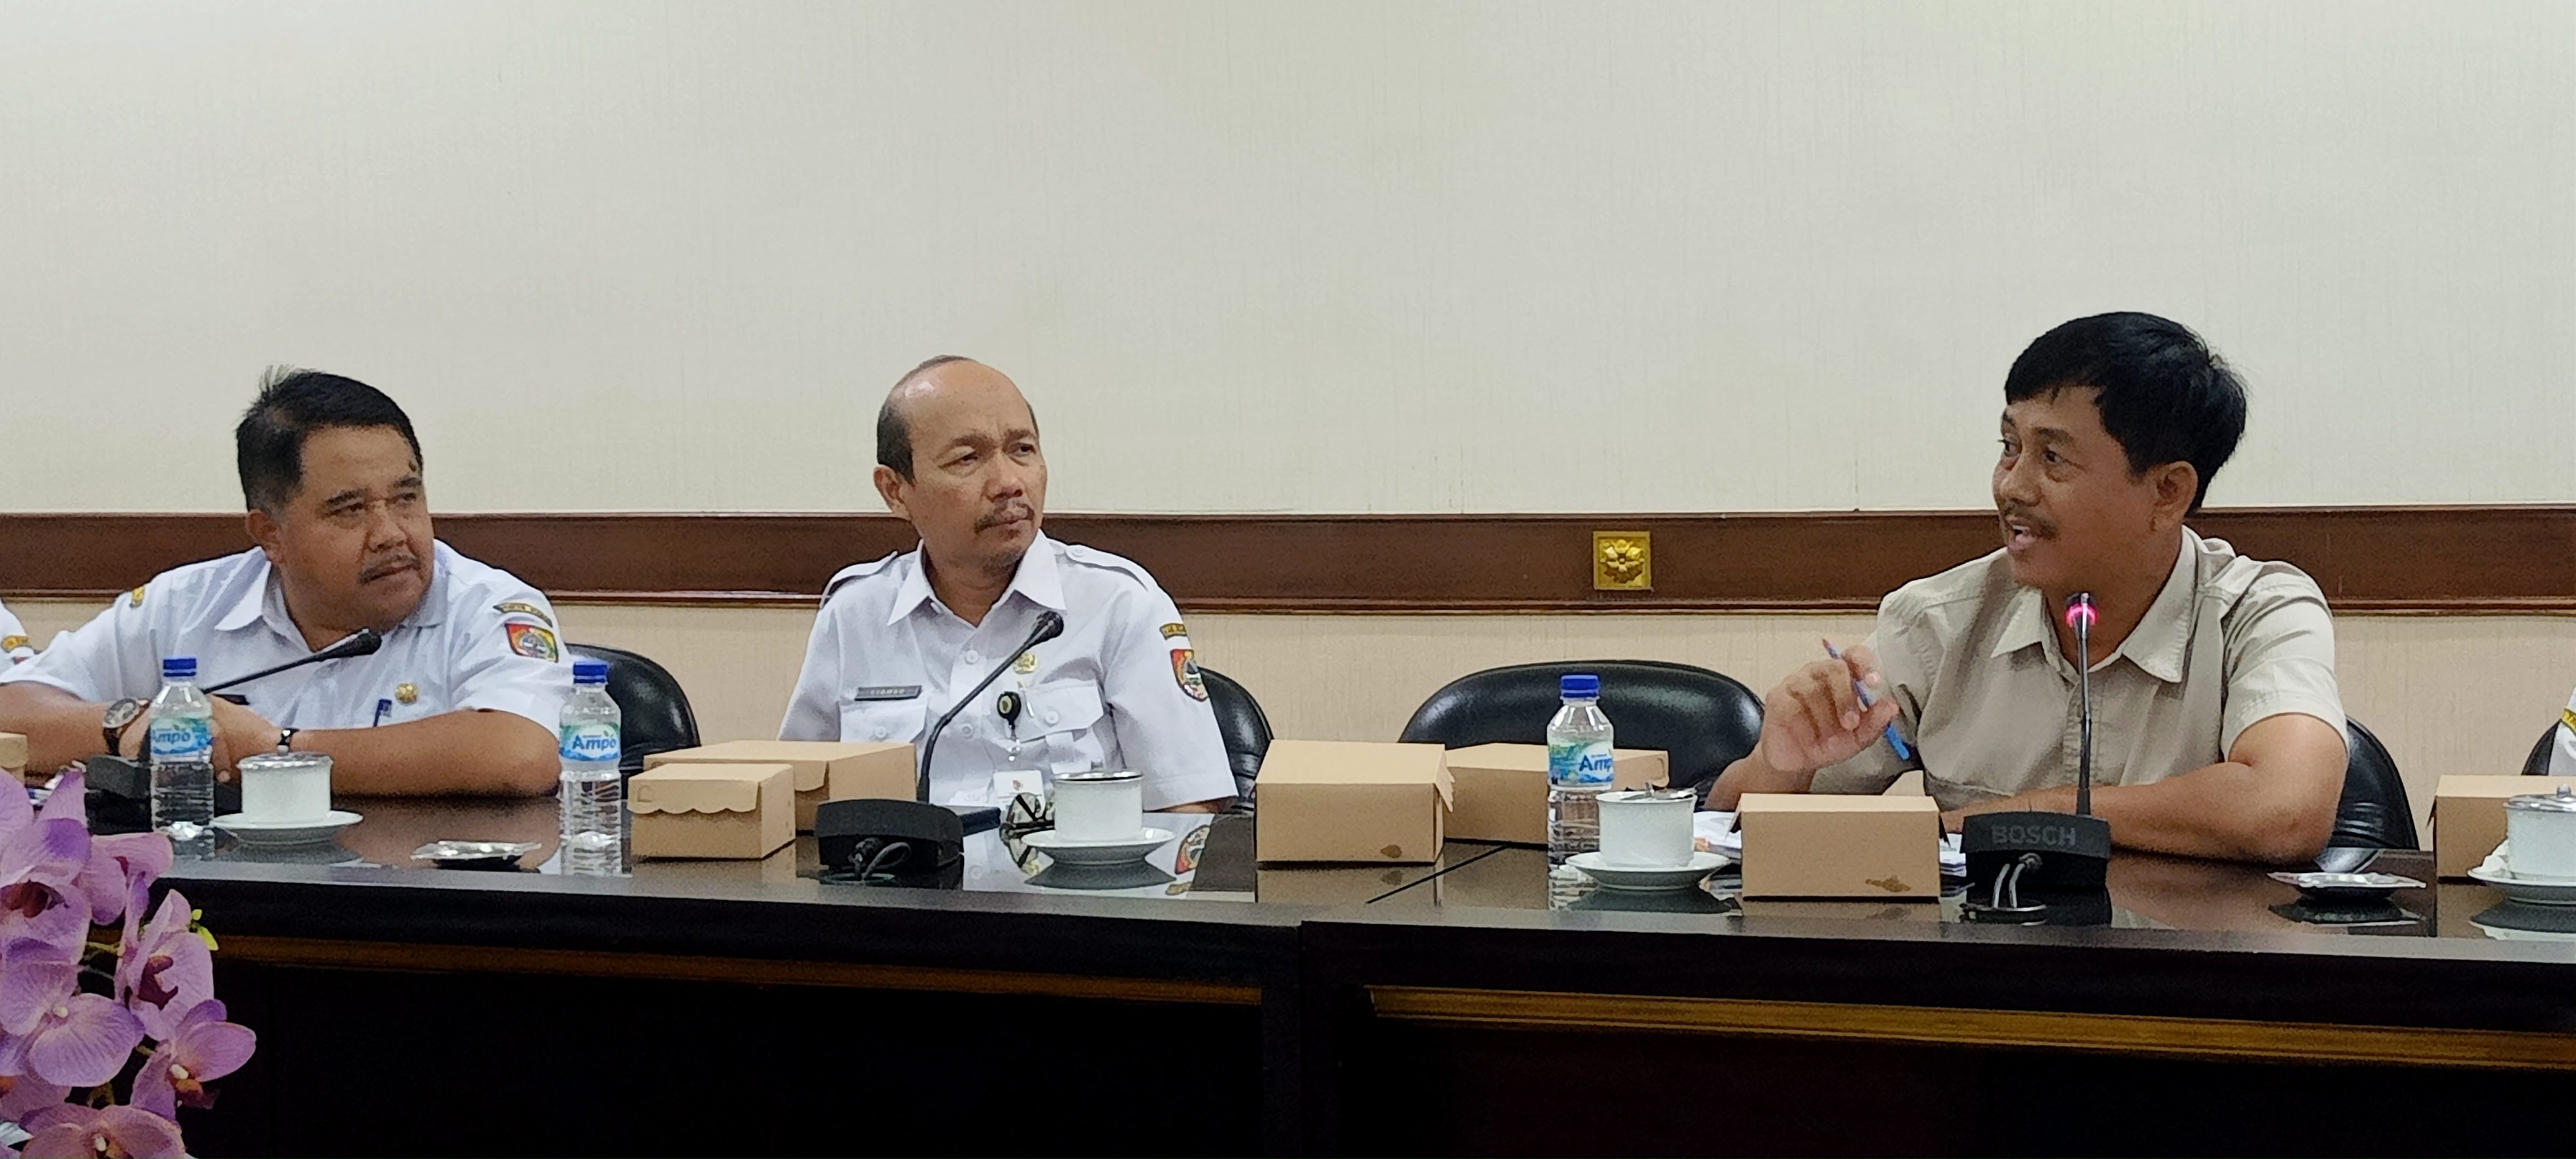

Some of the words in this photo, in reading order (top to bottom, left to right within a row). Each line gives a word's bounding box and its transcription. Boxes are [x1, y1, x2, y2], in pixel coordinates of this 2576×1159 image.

[572, 735, 616, 751] Ampo
[1579, 755, 1613, 772] Amp
[1991, 825, 2076, 846] BOSCH
